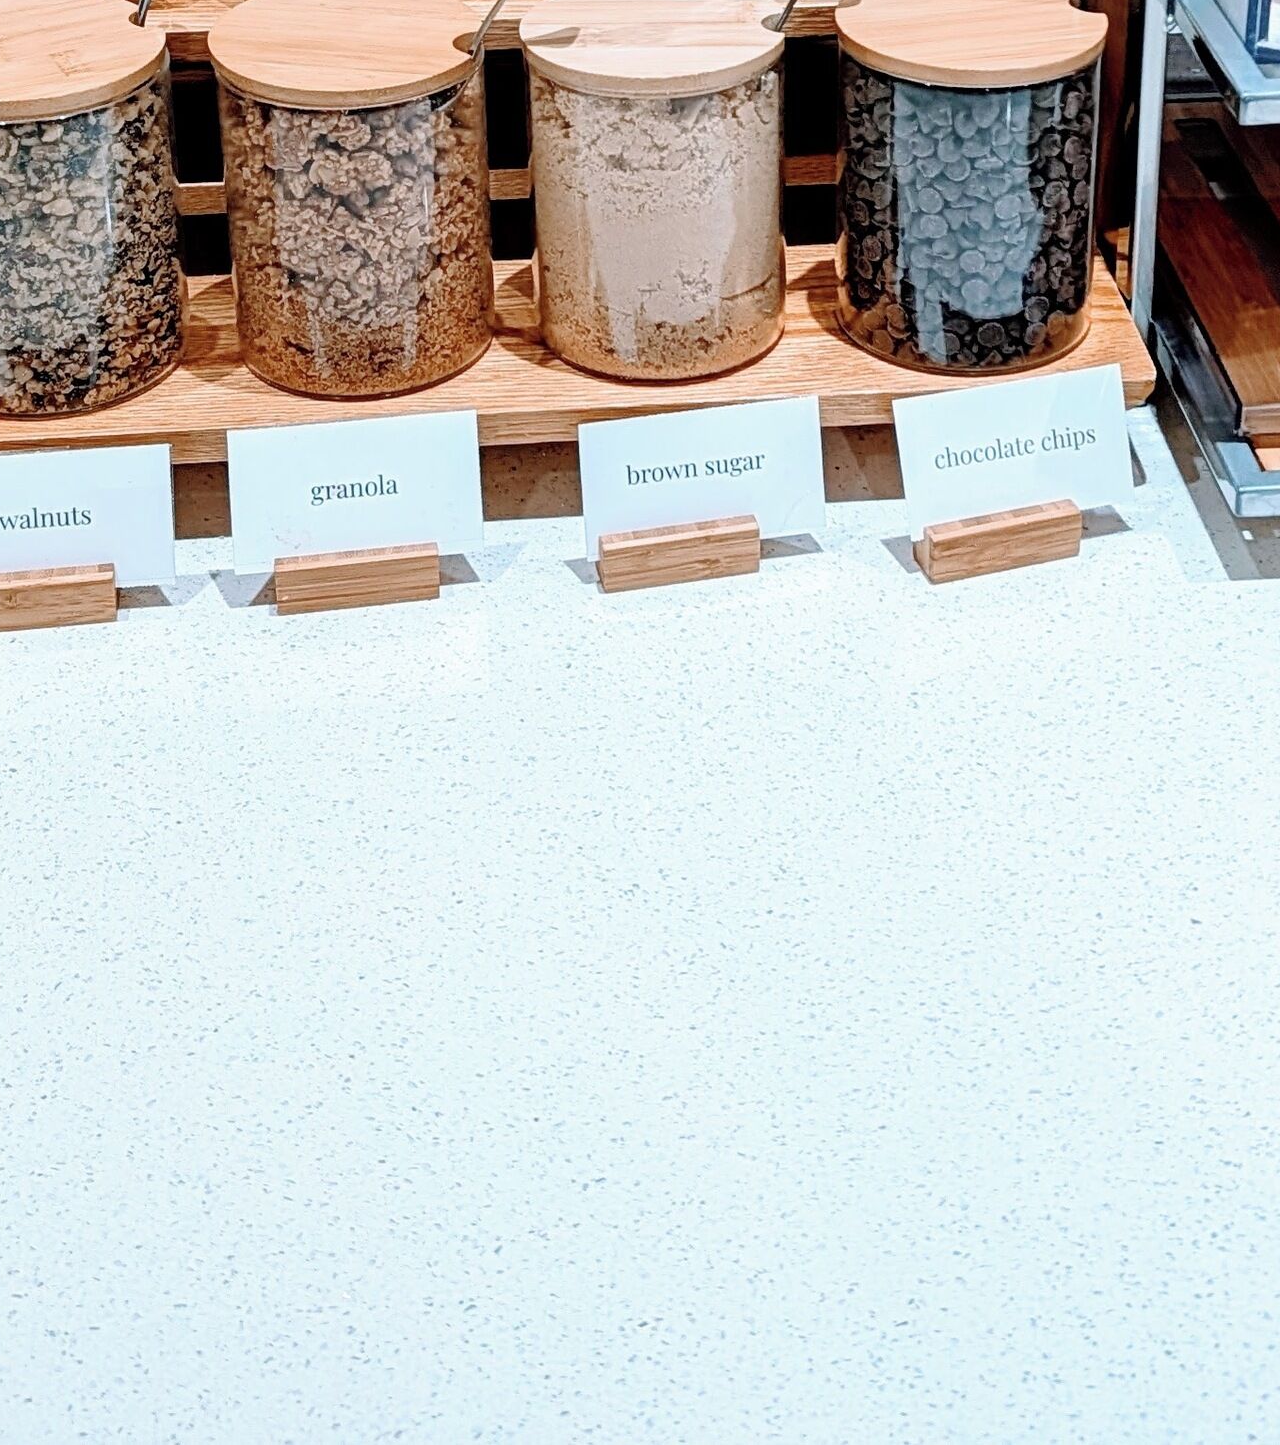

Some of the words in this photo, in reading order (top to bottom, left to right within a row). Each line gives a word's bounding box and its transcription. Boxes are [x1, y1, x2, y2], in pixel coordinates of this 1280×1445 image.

[934, 437, 1035, 470] chocolate
[1041, 426, 1096, 453] chips
[626, 462, 698, 486] brown
[704, 452, 766, 477] sugar
[310, 474, 399, 507] granola
